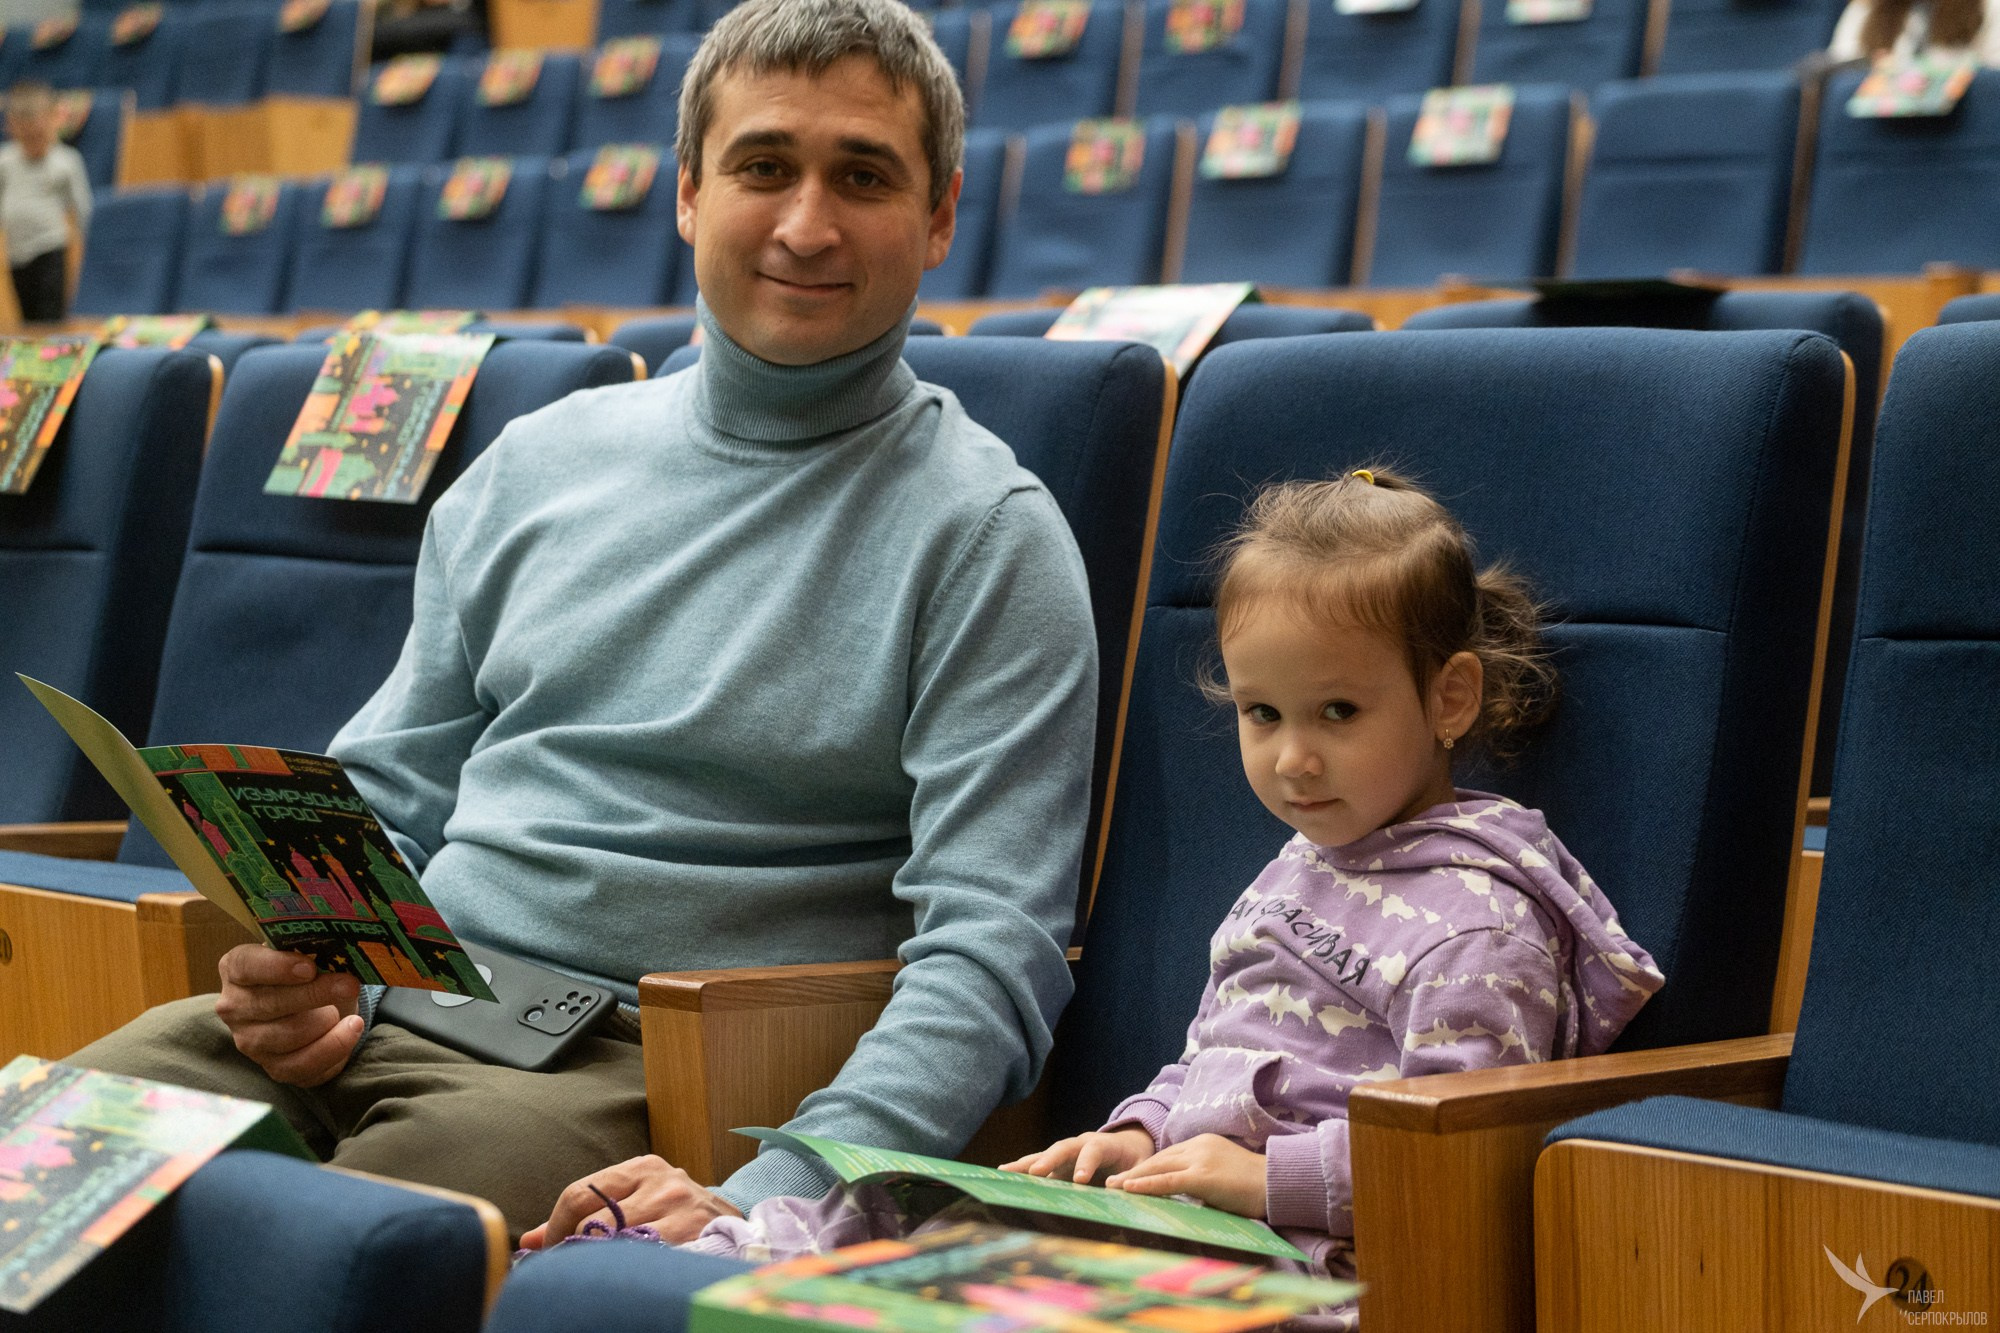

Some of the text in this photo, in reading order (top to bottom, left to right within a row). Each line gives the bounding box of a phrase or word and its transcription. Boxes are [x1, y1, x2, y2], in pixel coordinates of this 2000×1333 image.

[229, 786, 371, 815] ИЗУМРУДНЫЙ
[250, 804, 323, 823] ГОРОД
[264, 920, 389, 937] НОВАЯ ГЛАВА
